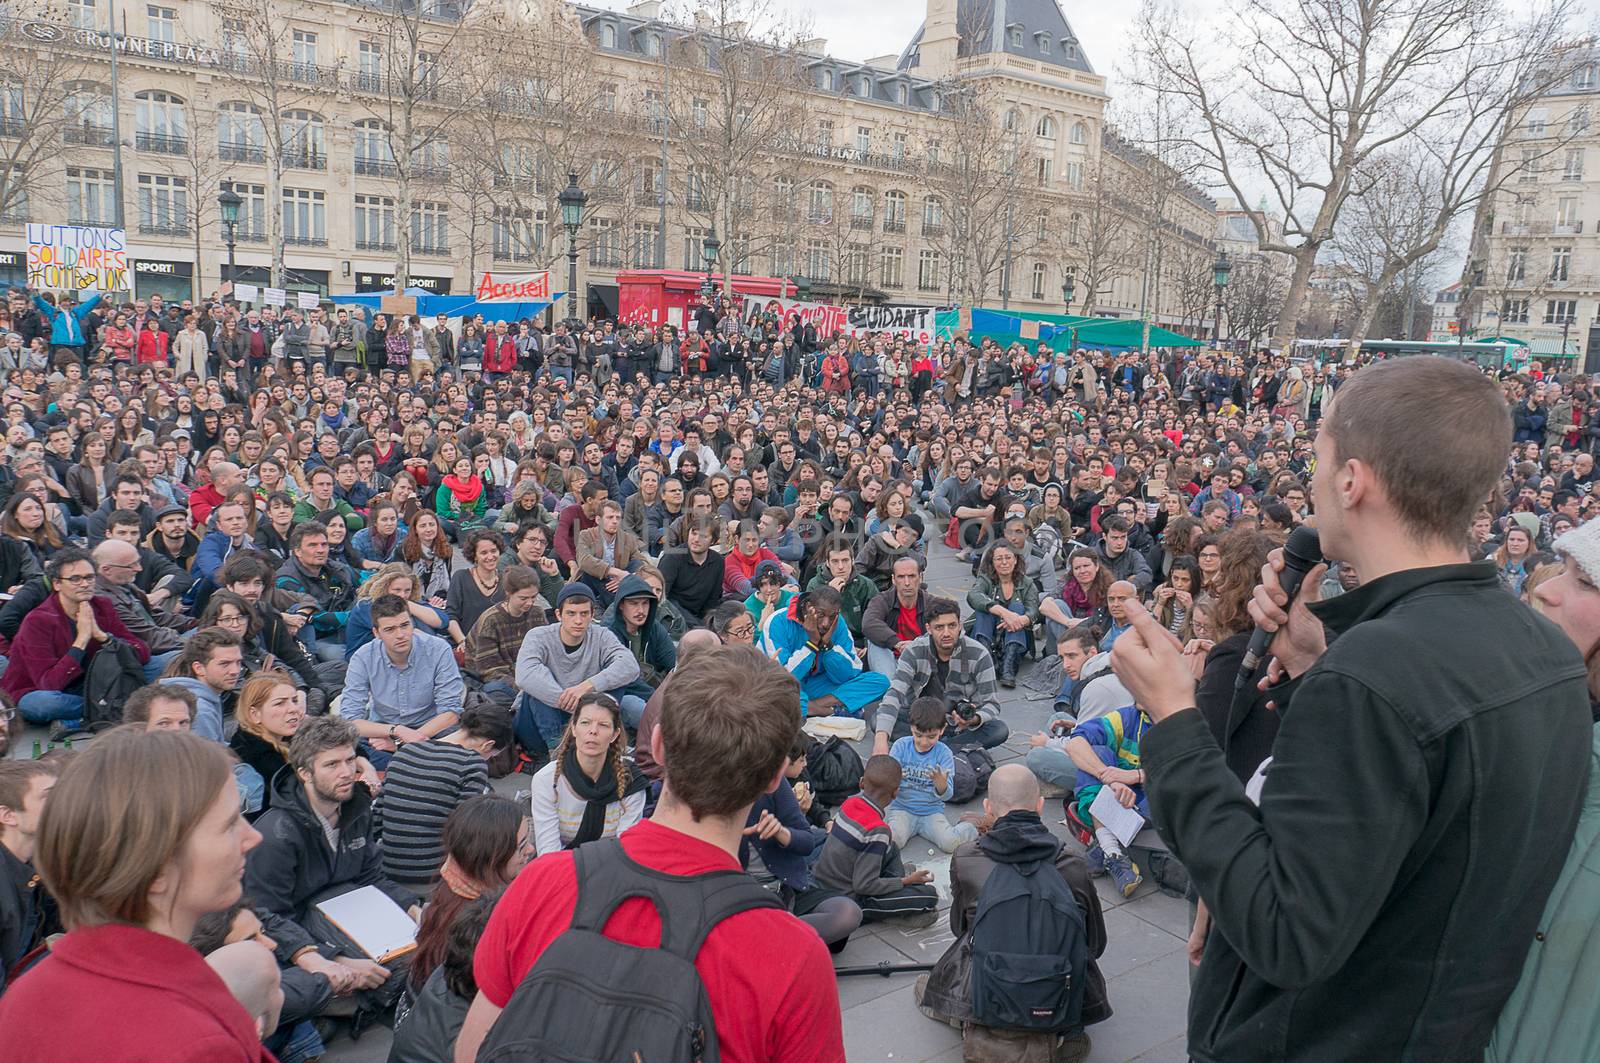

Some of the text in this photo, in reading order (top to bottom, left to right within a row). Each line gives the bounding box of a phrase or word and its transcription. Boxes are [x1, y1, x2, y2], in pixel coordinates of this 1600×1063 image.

[74, 30, 221, 65] CROWNE PLAZA
[28, 223, 123, 251] LUTTONS
[28, 244, 126, 271] SOLIDAIRES
[136, 262, 172, 273] SPORT
[408, 279, 436, 288] SPORT
[476, 271, 549, 301] Accueil
[848, 307, 930, 329] GUIDANT
